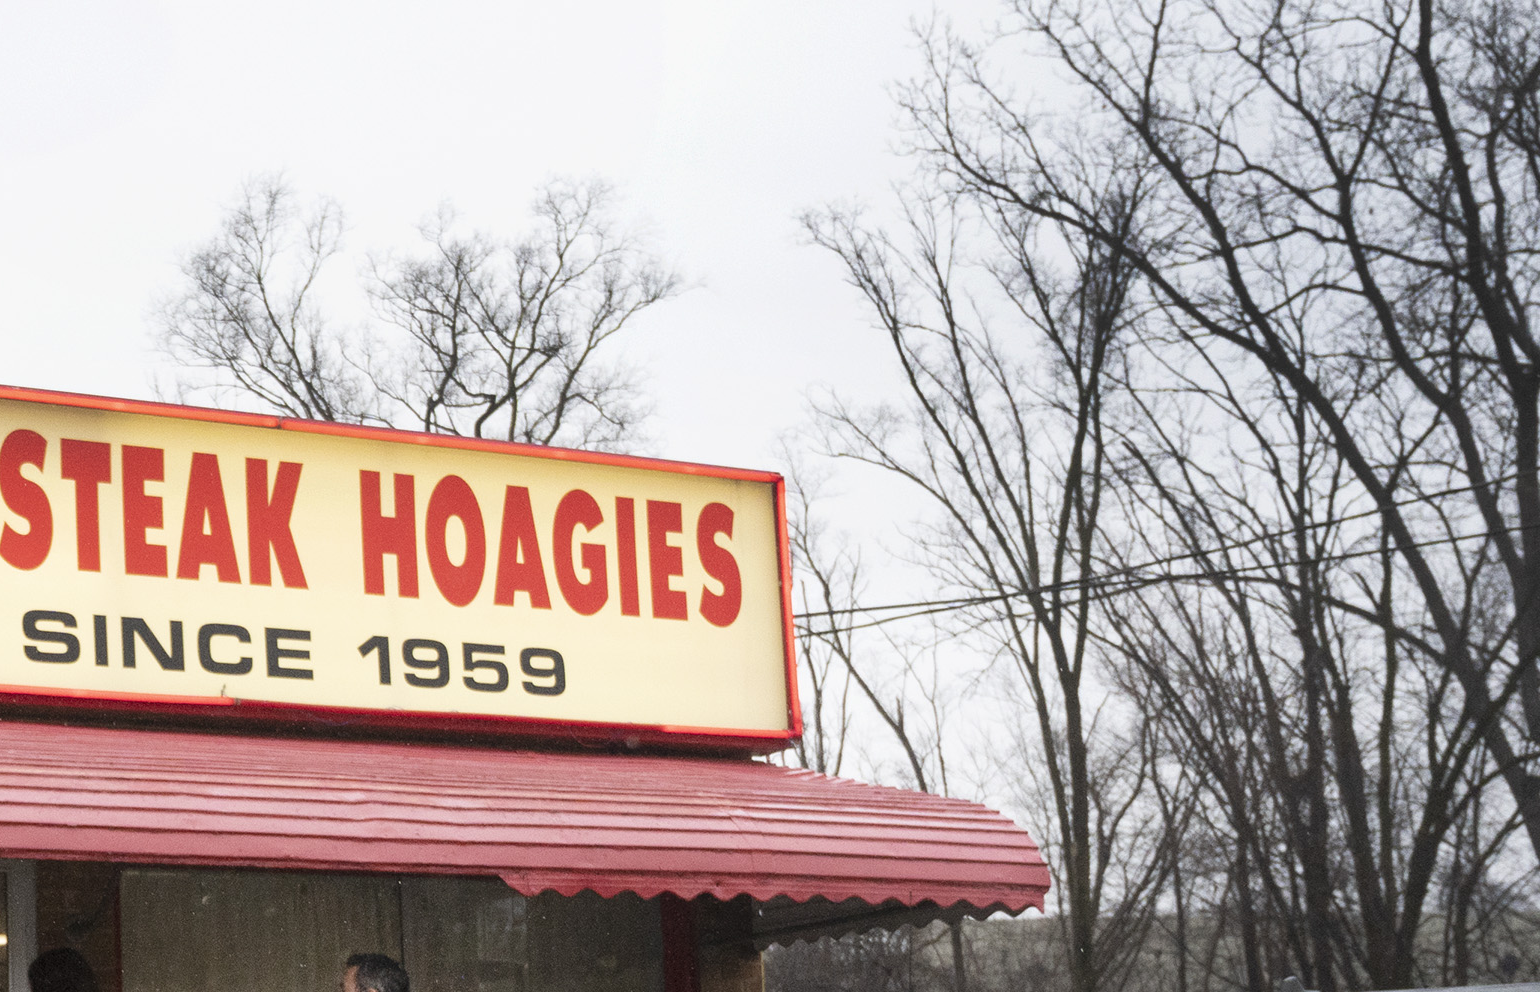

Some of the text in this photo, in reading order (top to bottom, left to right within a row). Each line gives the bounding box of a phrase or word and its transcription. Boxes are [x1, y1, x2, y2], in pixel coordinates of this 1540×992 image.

[360, 470, 742, 627] HOAGIES
[22, 609, 313, 680] SINCE
[358, 635, 567, 696] 1959
